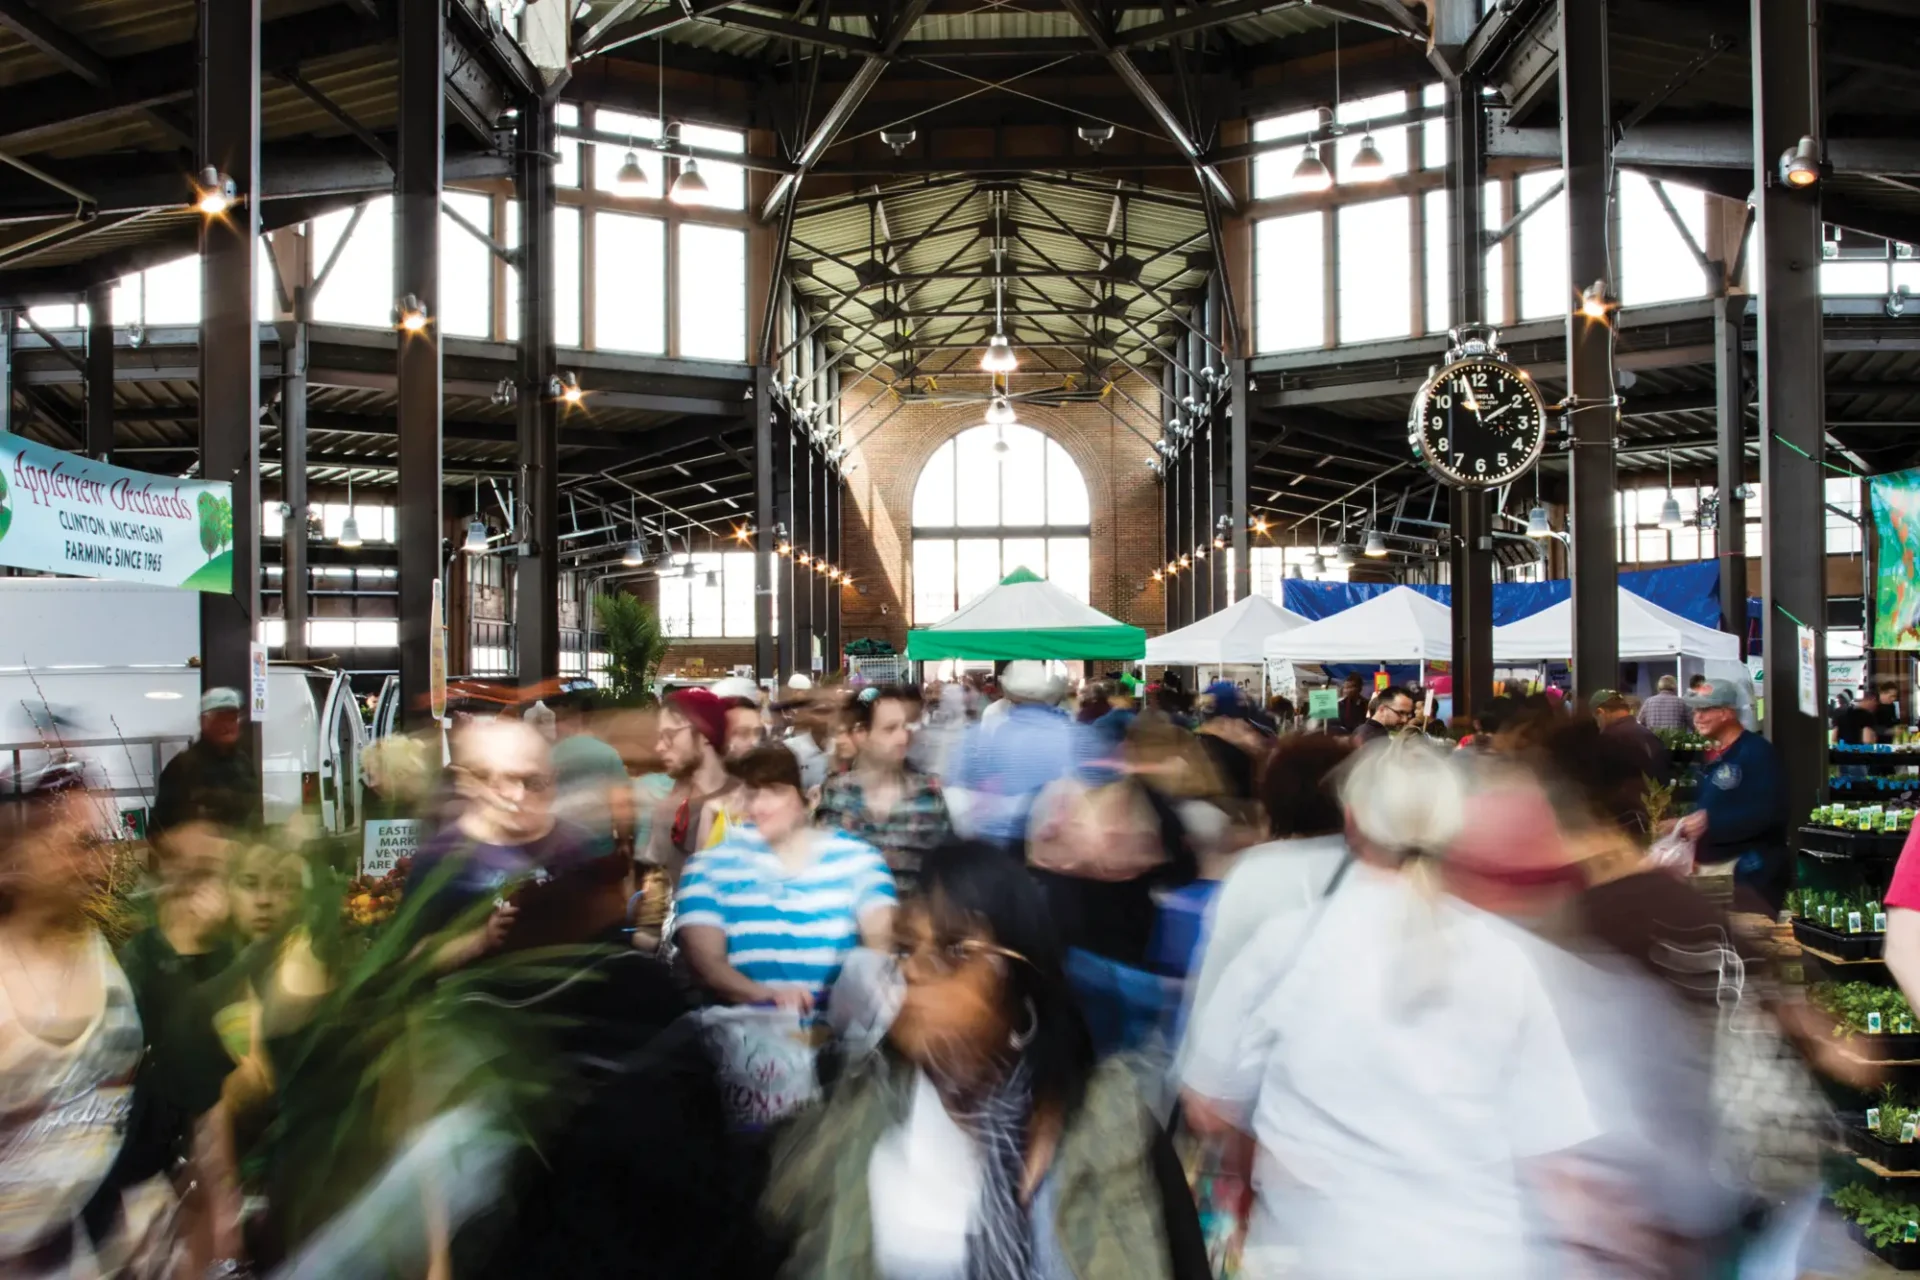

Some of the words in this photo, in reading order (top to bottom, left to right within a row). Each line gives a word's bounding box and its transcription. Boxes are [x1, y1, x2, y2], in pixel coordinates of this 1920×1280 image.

[1452, 379, 1465, 393] 11
[1471, 373, 1488, 387] 12
[1497, 379, 1504, 393] 1
[1435, 395, 1452, 409] 10
[1512, 394, 1523, 409] 2
[1432, 416, 1443, 430] 9
[1518, 415, 1528, 430] 3
[1438, 437, 1449, 452] 8
[1511, 436, 1524, 451] 4
[1454, 453, 1464, 467] 7
[1475, 458, 1486, 472] 6
[1497, 452, 1508, 467] 5
[14, 450, 108, 508] Appleview
[110, 477, 192, 520] Orchards
[58, 510, 111, 539] CLINTON,
[112, 520, 164, 544] MICHIGAN
[65, 540, 112, 566] FARMING
[115, 549, 142, 572] SINCE
[144, 553, 162, 572] 1965
[375, 848, 418, 858] VENDO
[368, 860, 392, 870] ARE
